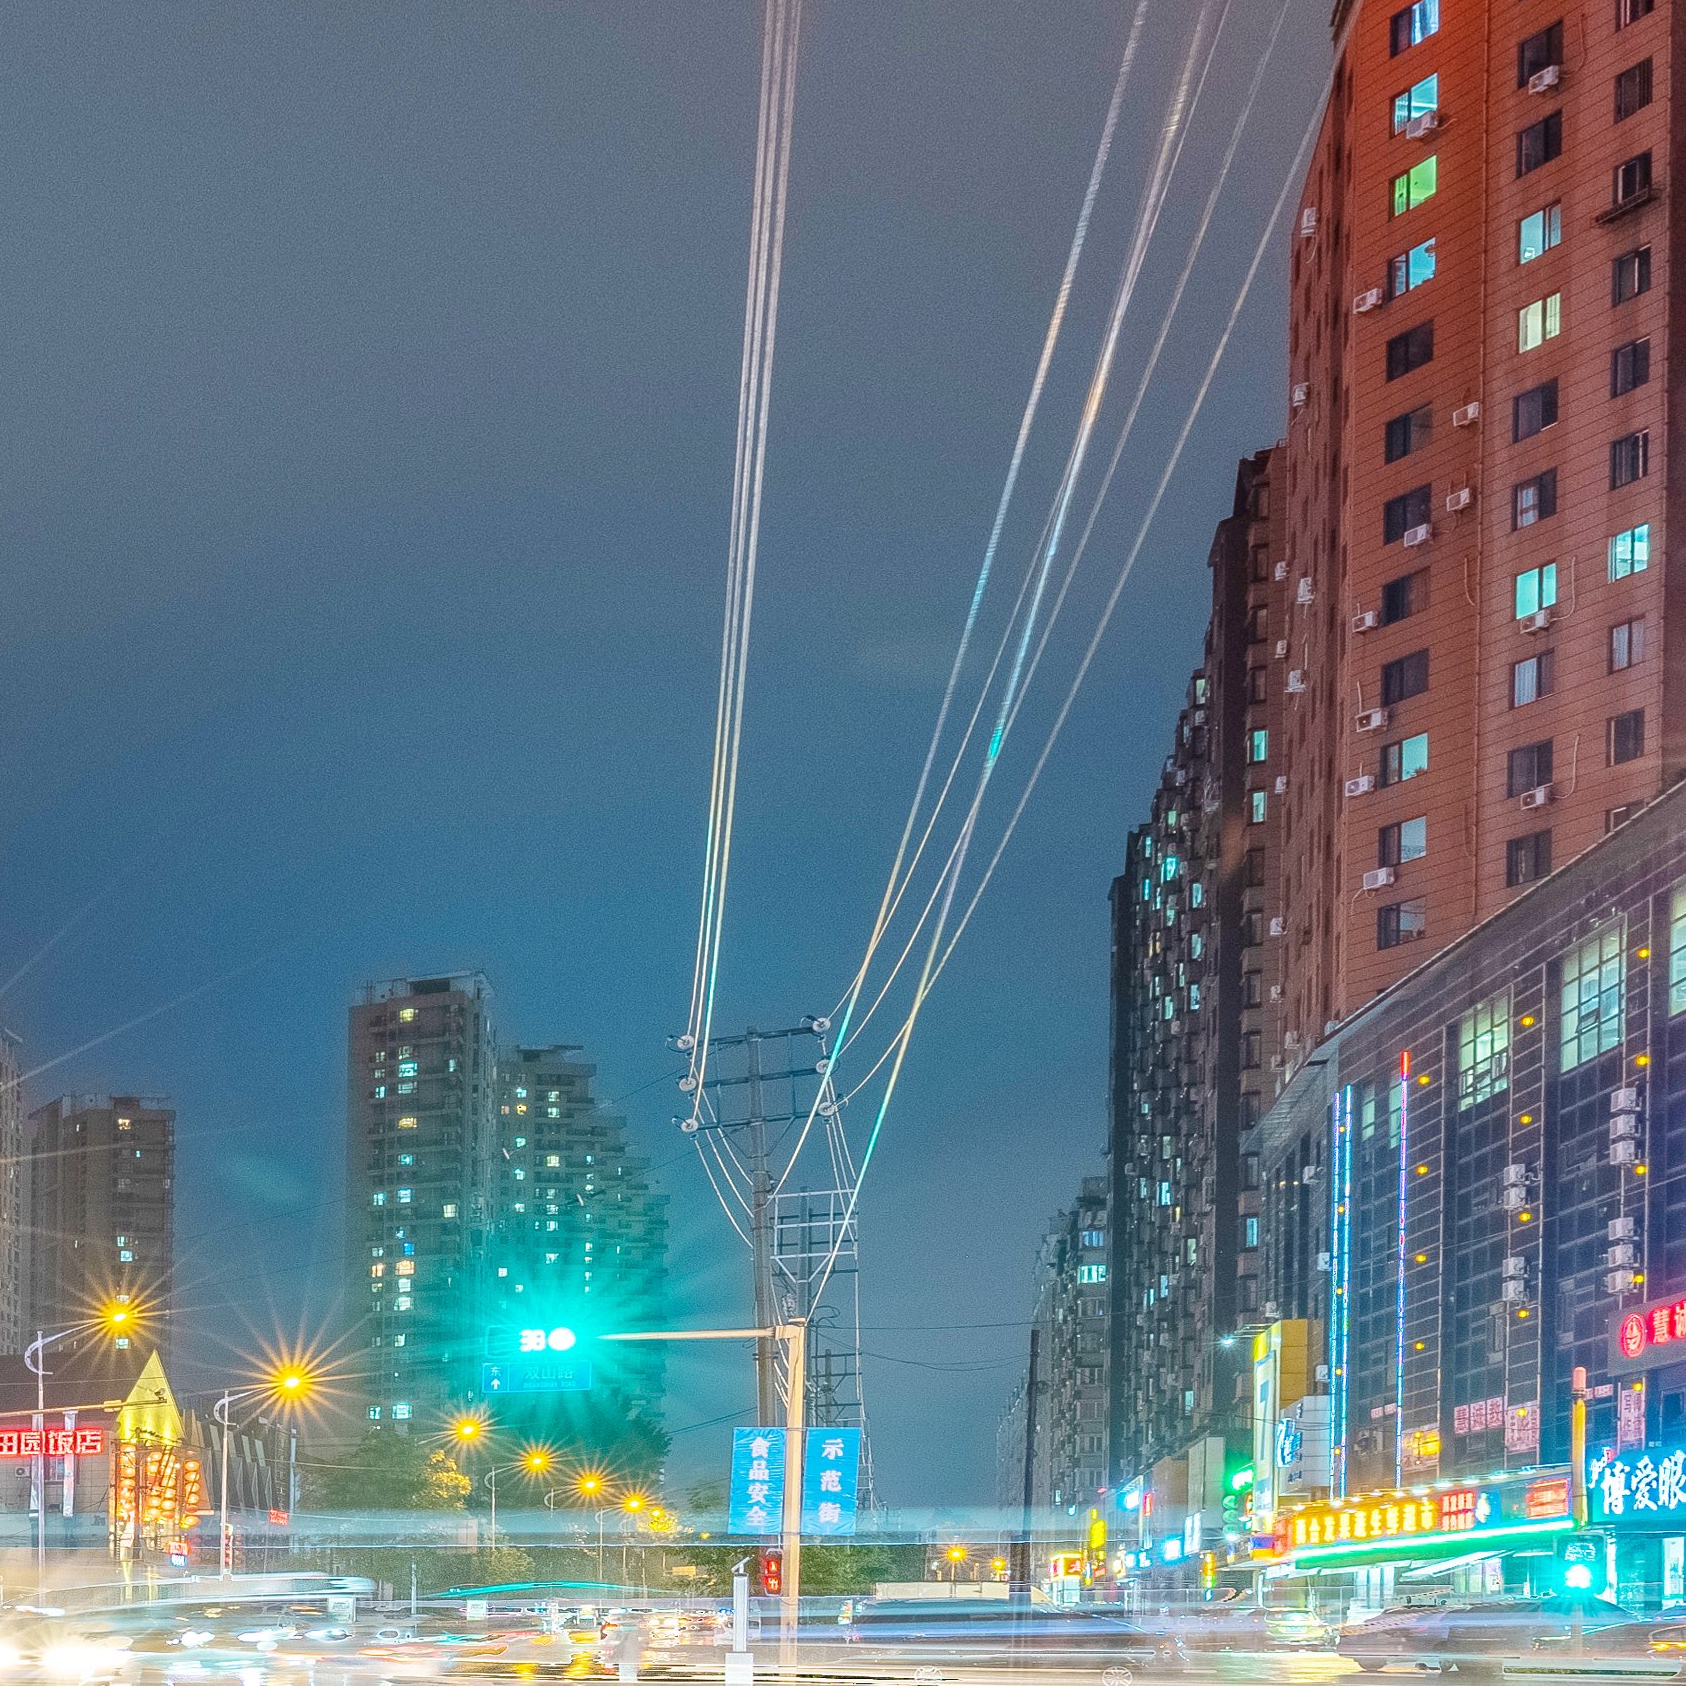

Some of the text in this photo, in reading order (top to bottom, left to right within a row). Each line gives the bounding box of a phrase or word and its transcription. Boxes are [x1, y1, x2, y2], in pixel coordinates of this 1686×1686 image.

[525, 1366, 574, 1379] 双山路
[746, 1436, 772, 1526] 食品安全
[818, 1439, 844, 1524] 示范街
